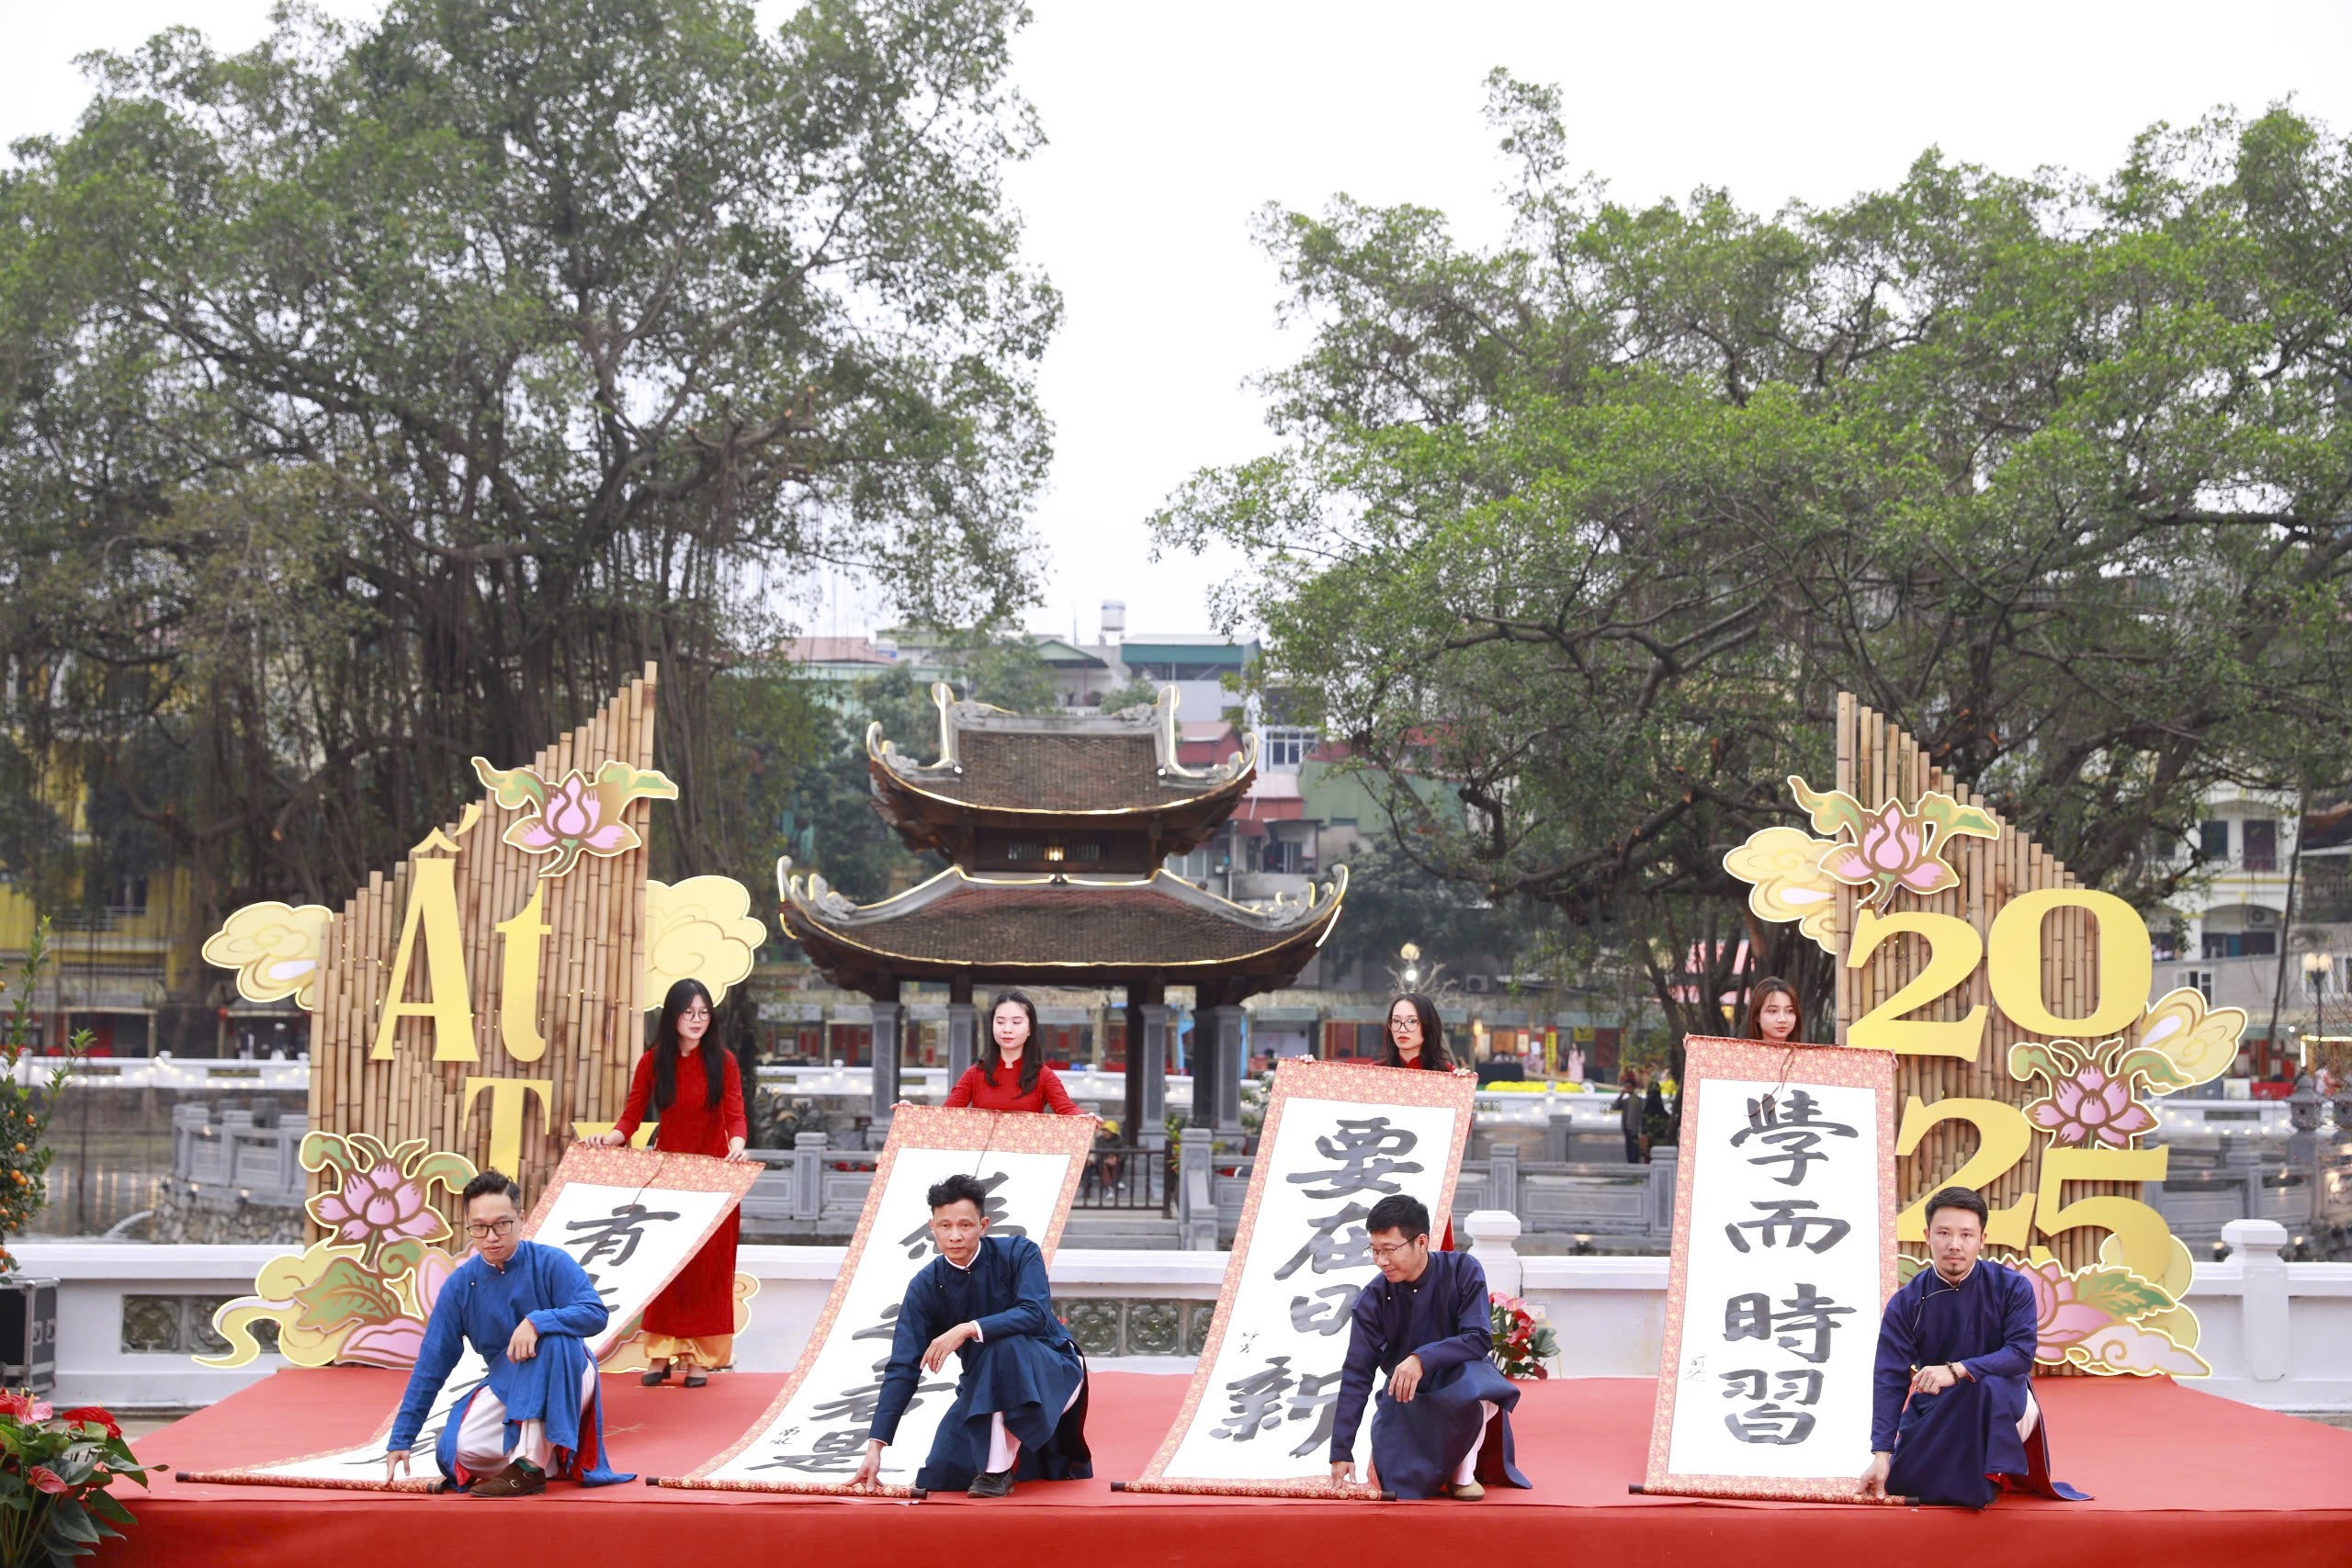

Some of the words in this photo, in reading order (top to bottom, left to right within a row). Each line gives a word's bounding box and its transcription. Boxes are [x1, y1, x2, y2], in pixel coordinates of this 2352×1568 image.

[368, 802, 552, 1063] Ất
[1846, 888, 2153, 1063] 20
[462, 1076, 660, 1183] T
[1895, 1095, 2172, 1284] 25
